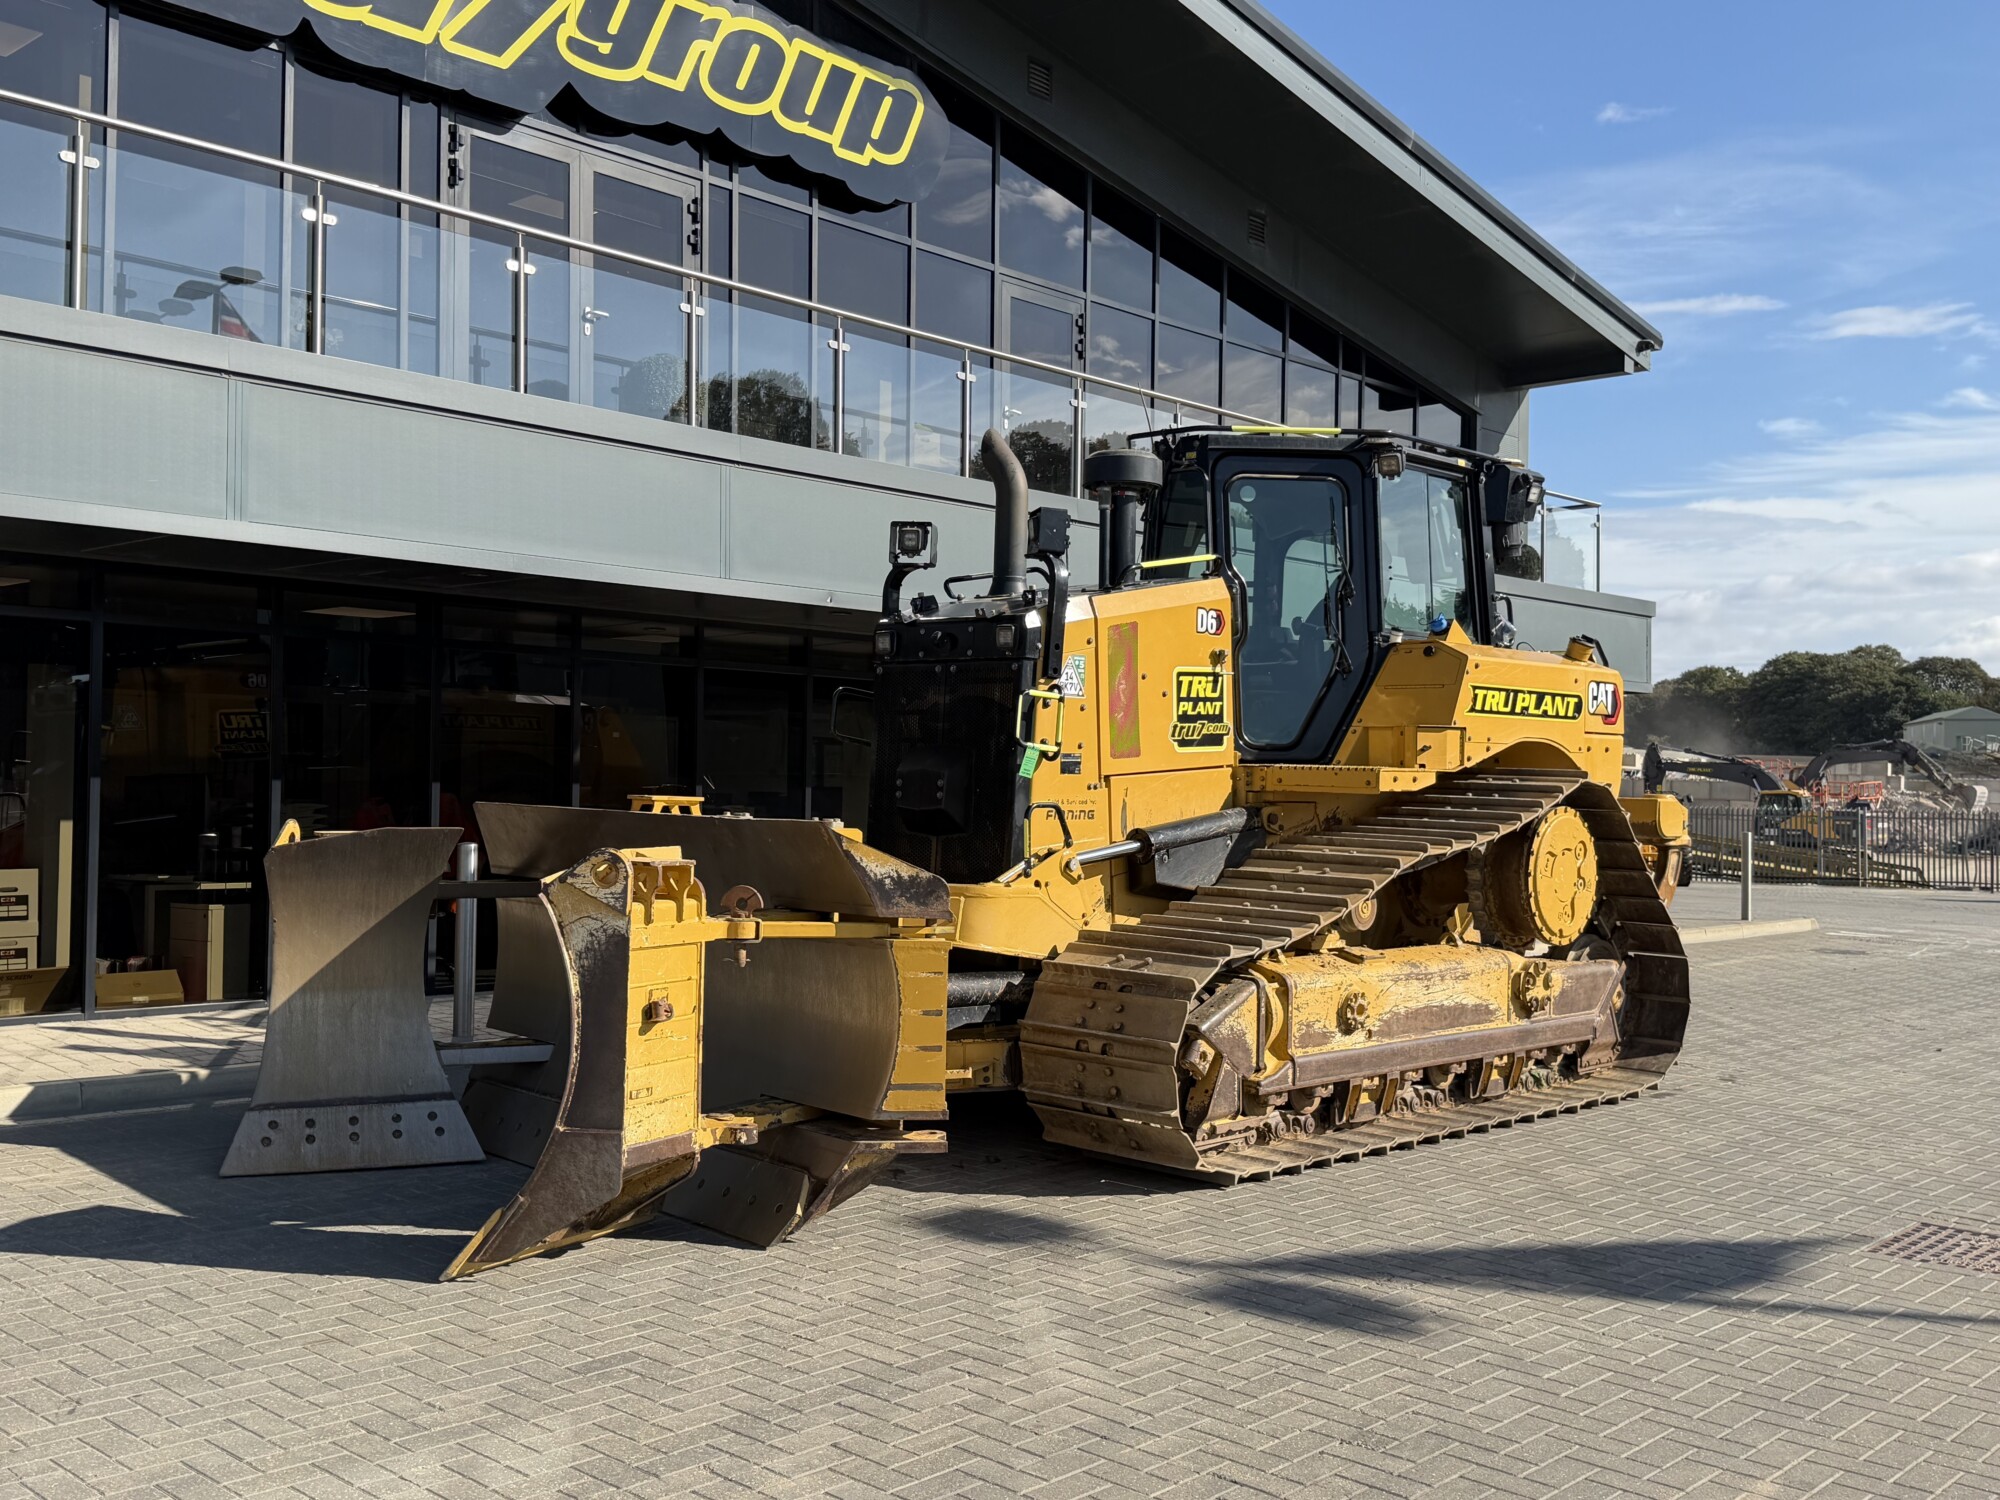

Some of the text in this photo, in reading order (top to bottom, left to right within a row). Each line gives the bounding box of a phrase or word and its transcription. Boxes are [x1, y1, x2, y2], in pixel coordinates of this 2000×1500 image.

[1197, 607, 1217, 635] D6
[1064, 671, 1074, 681] 14
[1179, 676, 1223, 698] TRU
[1178, 701, 1223, 715] PLANT
[1475, 689, 1579, 717] TRU PLANT
[1588, 681, 1615, 716] CAT
